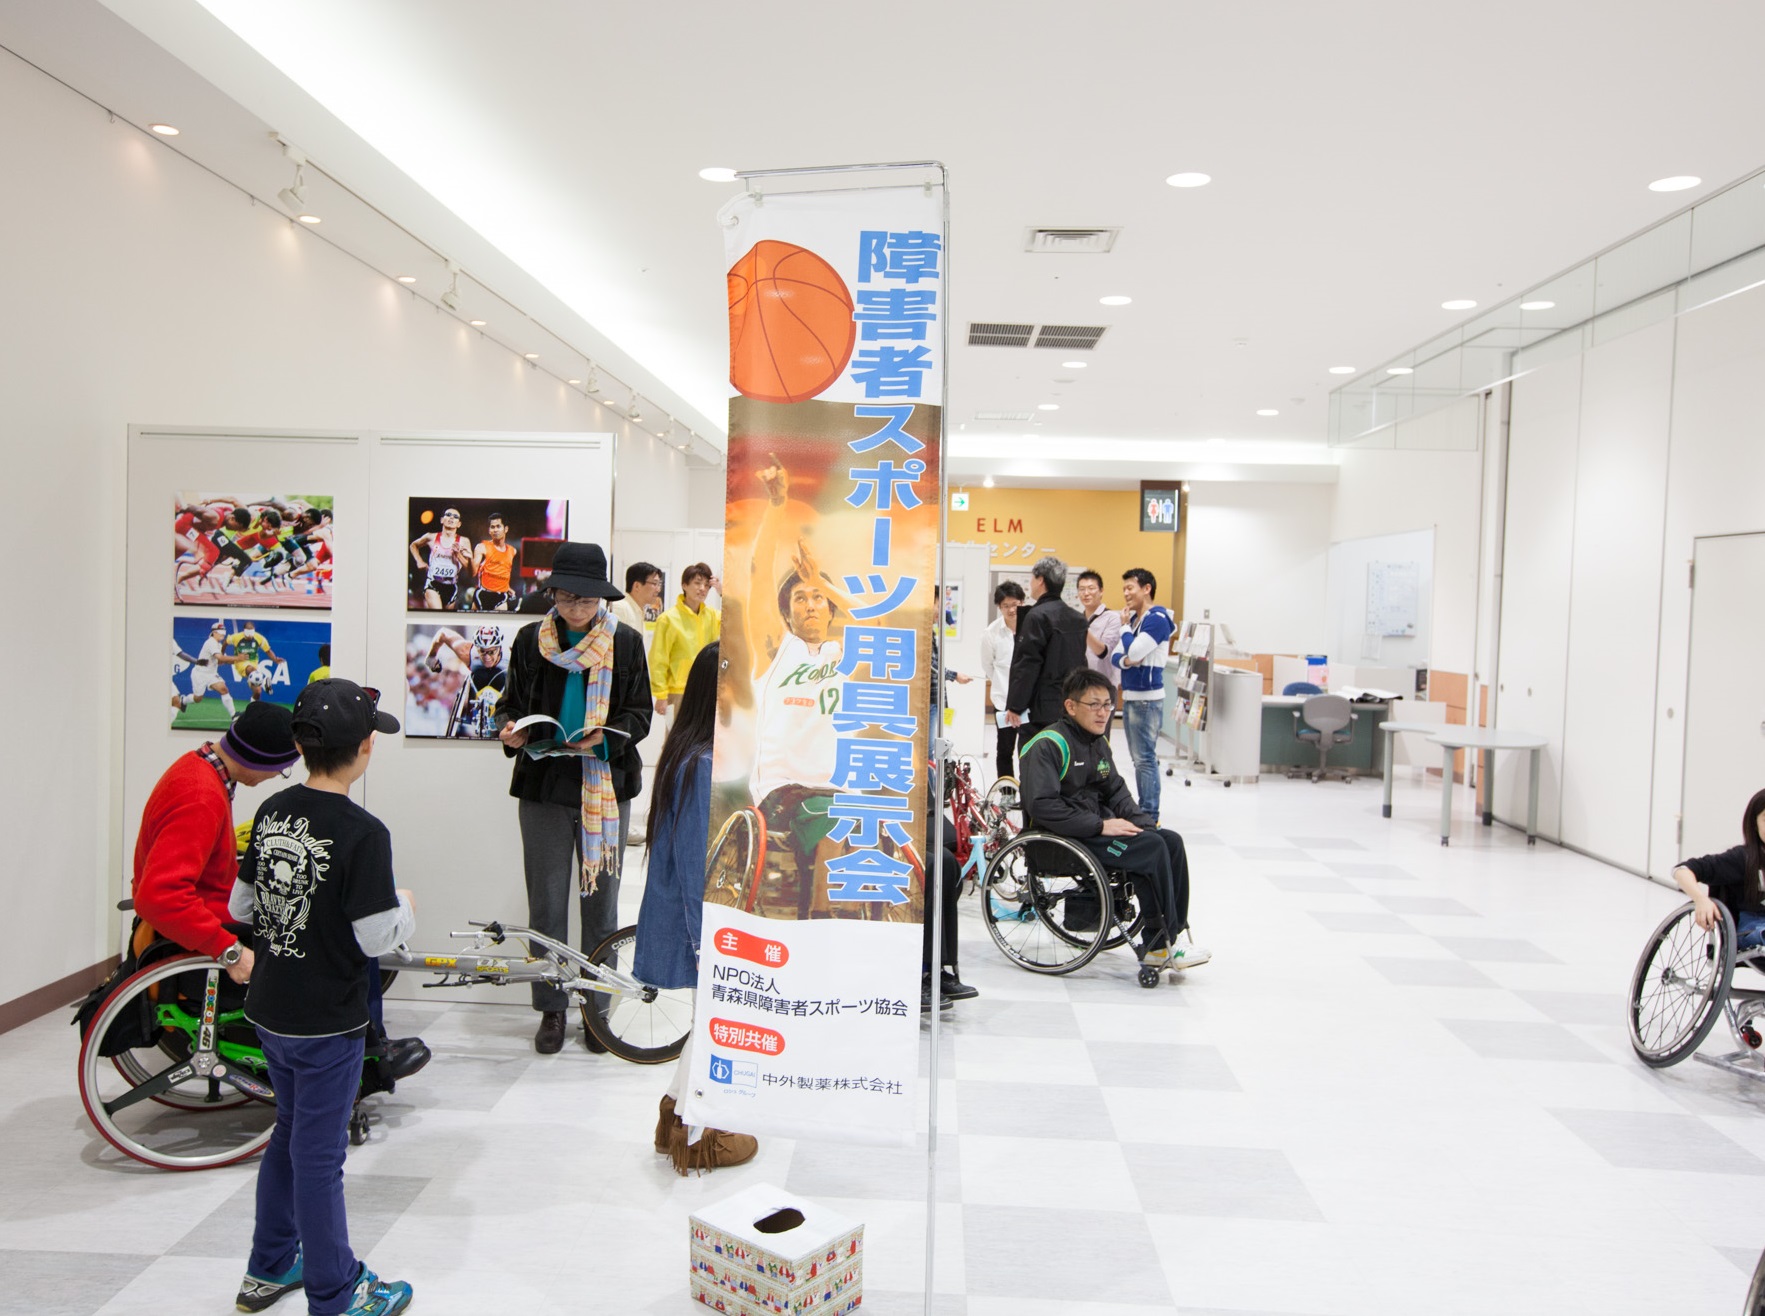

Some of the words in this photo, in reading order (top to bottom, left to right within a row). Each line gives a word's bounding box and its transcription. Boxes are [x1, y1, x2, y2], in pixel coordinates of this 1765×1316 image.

[976, 517, 1023, 533] ELM
[434, 567, 454, 576] 2459
[825, 230, 941, 905] 障害者スポーツ用具展示会
[713, 964, 780, 995] NPO法人
[712, 983, 908, 1018] 青森県障害者スポーツ協会
[201, 1026, 212, 1050] 46
[713, 1023, 779, 1053] 特別共催
[762, 1073, 904, 1096] 中外製薬株式会社
